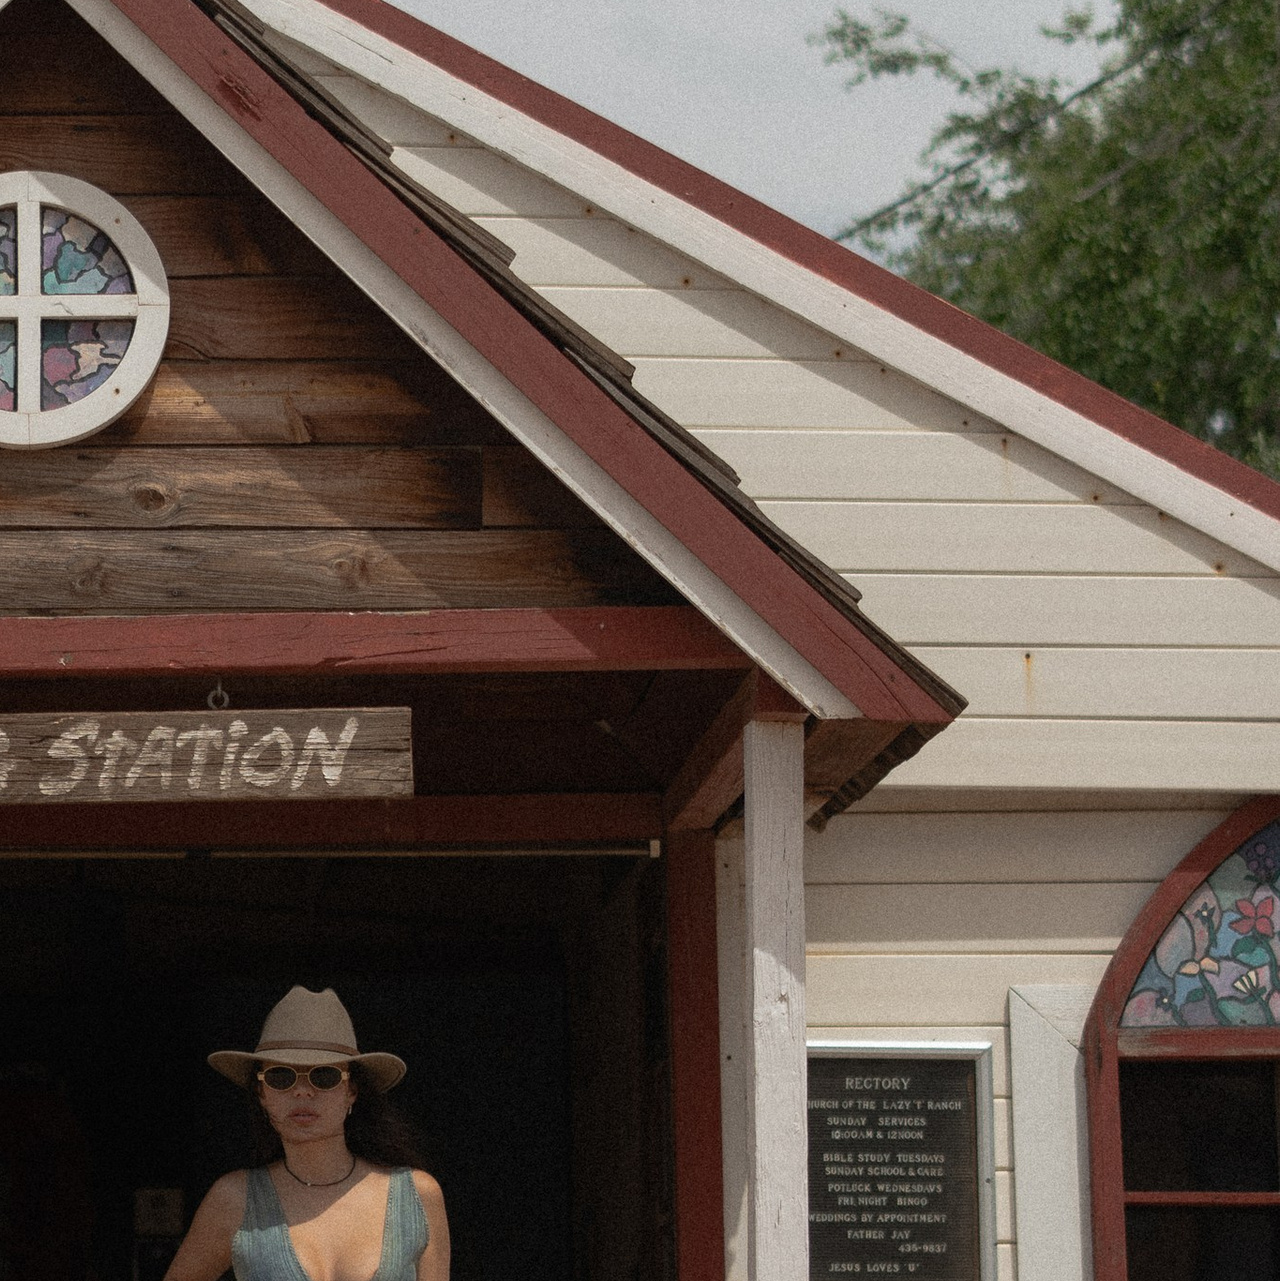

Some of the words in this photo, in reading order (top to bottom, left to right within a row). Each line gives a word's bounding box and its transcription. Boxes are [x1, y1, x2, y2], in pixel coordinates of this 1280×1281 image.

[845, 1078, 911, 1090] RECTORY
[807, 1100, 839, 1109] HURCH
[842, 1100, 853, 1109] OF
[856, 1100, 875, 1110] THE
[883, 1101, 910, 1110] LAZY
[927, 1101, 961, 1110] RANCH
[827, 1117, 867, 1126] SUNDAY
[878, 1117, 926, 1126] SERVICES
[876, 1131, 883, 1139] &
[823, 1153, 853, 1162] BIBLE
[858, 1153, 890, 1162] STUDY
[896, 1154, 944, 1163] TUESDAYS
[825, 1167, 863, 1176] SUNDAY
[867, 1167, 906, 1176] SCHOOL
[908, 1168, 915, 1176] &
[917, 1167, 943, 1176] CARE
[828, 1183, 870, 1192] POTLUCK
[858, 1197, 887, 1206] NIGHT
[897, 1197, 927, 1206] BINGO
[861, 1213, 873, 1222] BY
[877, 1214, 947, 1223] APPOINTMENT
[847, 1230, 884, 1239] FATHER
[891, 1230, 910, 1239] JAY
[829, 1263, 860, 1272] JESUS
[867, 1263, 899, 1272] LOVES
